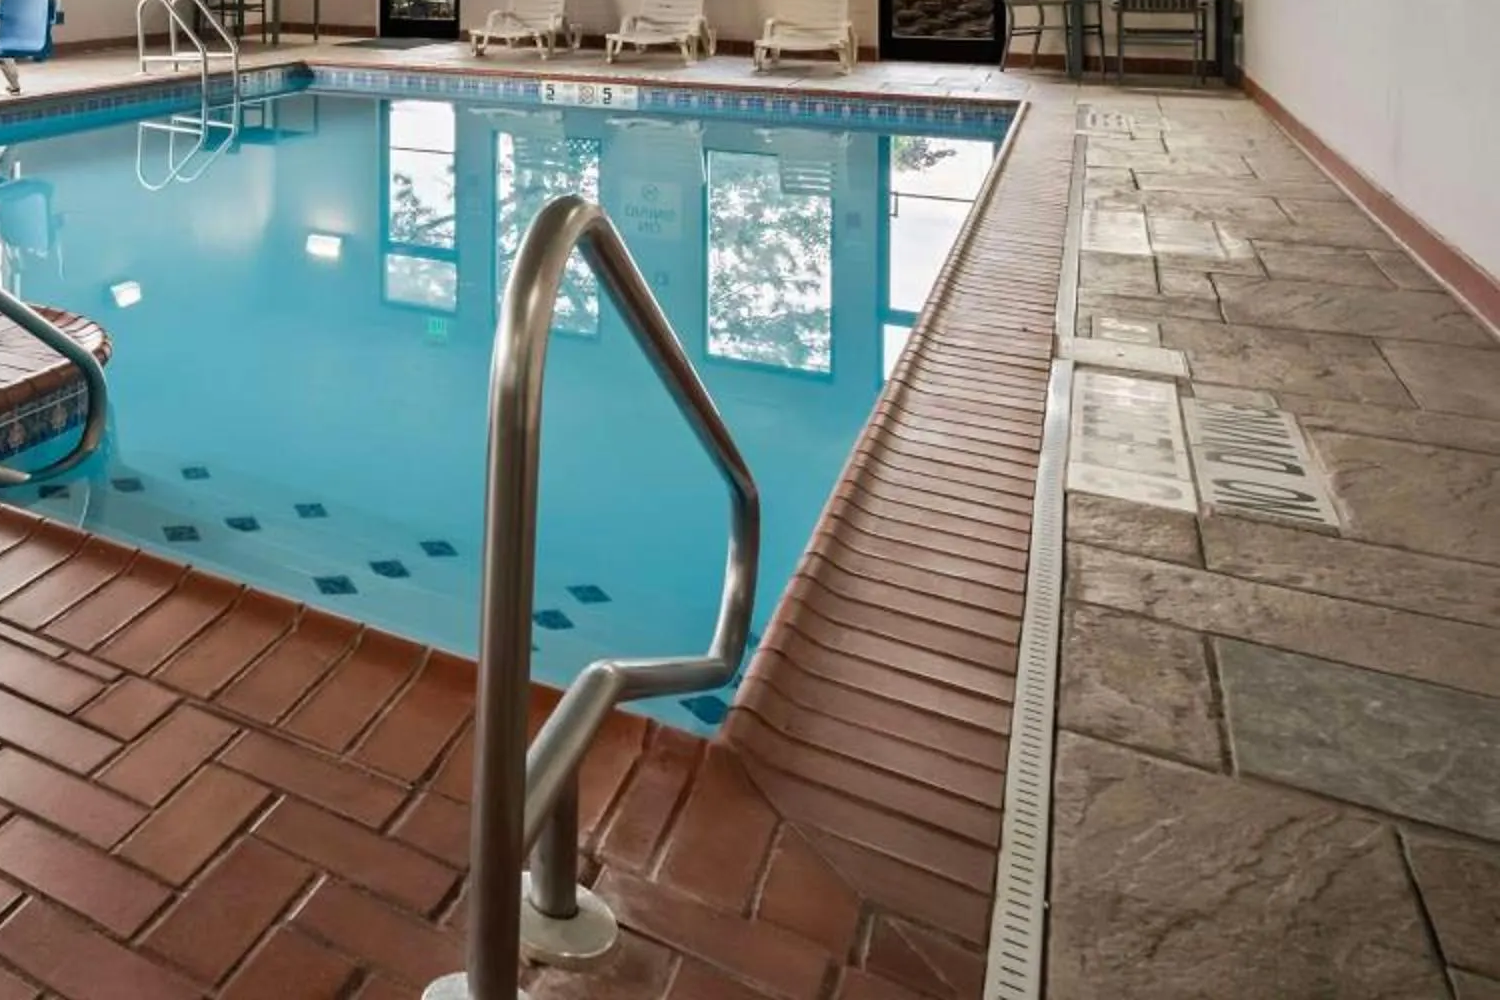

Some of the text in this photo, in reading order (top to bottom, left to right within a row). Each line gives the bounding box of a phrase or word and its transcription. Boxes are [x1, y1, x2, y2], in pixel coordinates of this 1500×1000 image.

[602, 87, 613, 105] 5
[1200, 402, 1326, 523] NO DIVING
